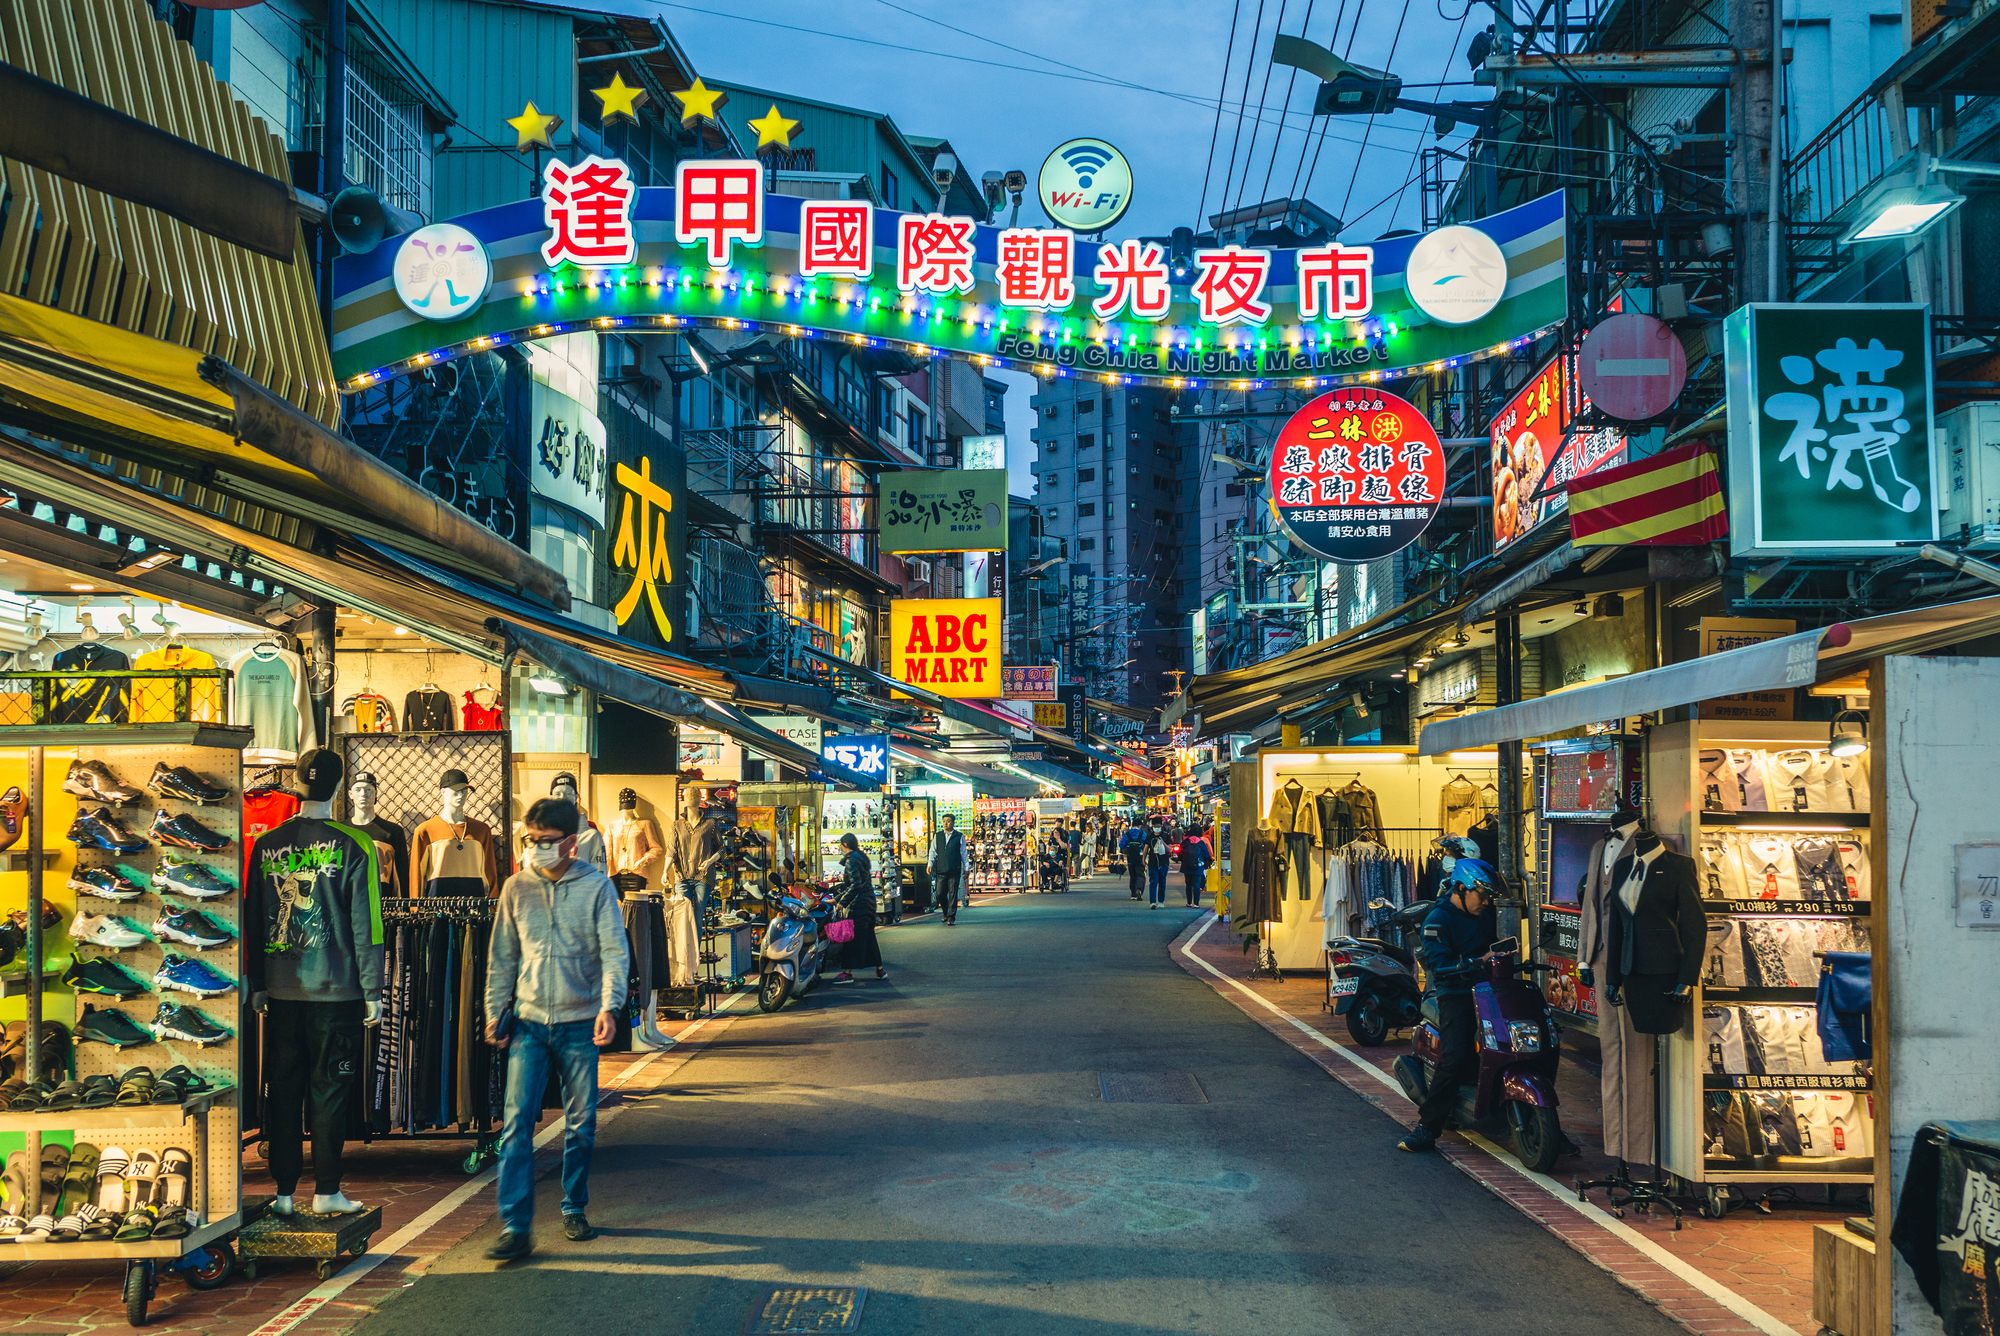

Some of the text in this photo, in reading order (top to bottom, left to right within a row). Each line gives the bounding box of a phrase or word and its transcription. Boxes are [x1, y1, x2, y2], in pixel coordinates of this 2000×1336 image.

[1051, 191, 1120, 211] Wi-Fi
[542, 158, 1371, 321] 逢甲國際觀光夜市
[998, 335, 1388, 373] Feng Chia Night Market
[1308, 414, 1368, 442] 二林
[1280, 443, 1431, 474] 藥燉排骨
[1328, 525, 1391, 538] 請安心食用
[905, 613, 988, 654] ABC
[905, 657, 988, 683] MART
[1073, 694, 1081, 744] SOLBERR
[1797, 902, 1820, 912] 290
[1835, 904, 1854, 912] 750
[1760, 1076, 1867, 1088] 開拓者西服襯衫領帶
